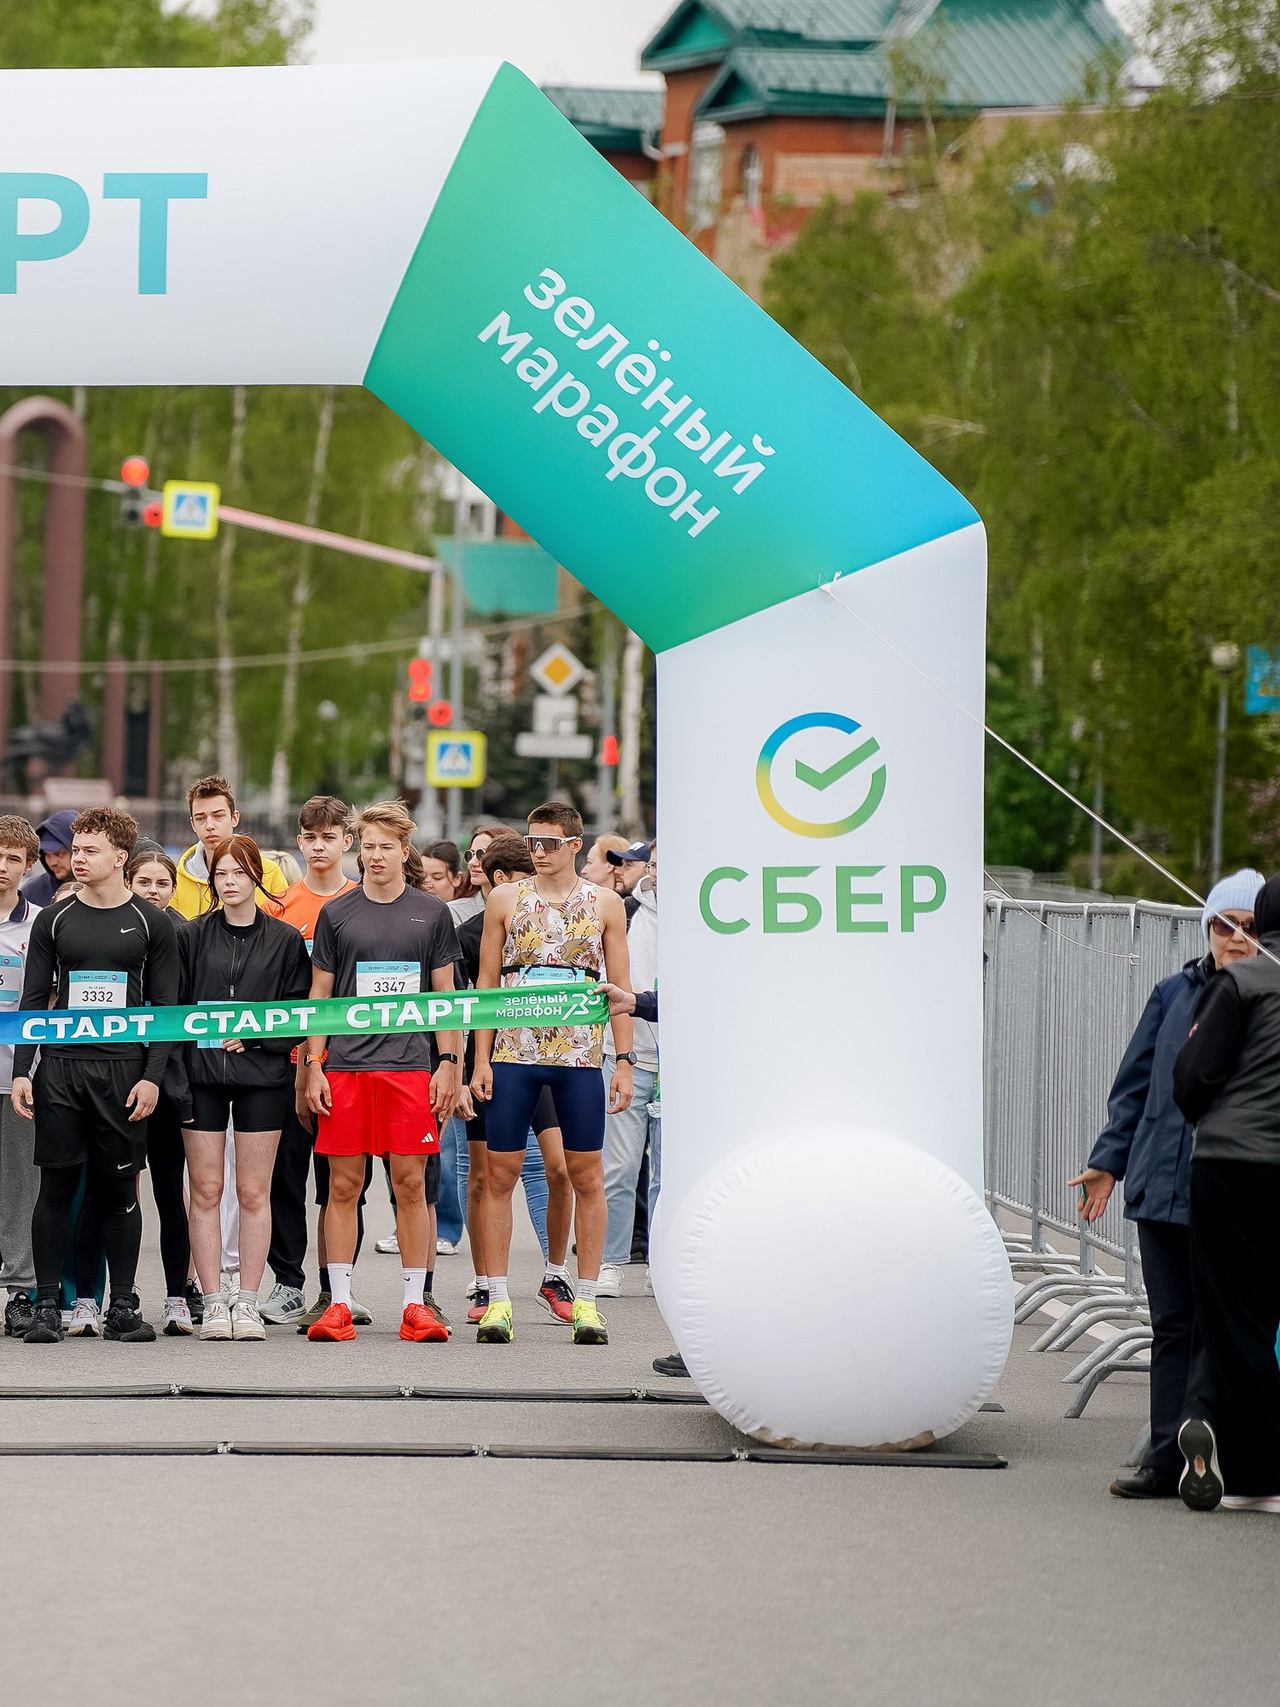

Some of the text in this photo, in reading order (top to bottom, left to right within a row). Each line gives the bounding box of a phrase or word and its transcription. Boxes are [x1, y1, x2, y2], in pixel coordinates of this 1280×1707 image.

[523, 267, 777, 496] зелёный
[477, 310, 721, 539] марафон
[699, 864, 947, 935] СБЕР
[82, 991, 114, 1003] 3332
[373, 981, 406, 993] 3347
[504, 991, 569, 1006] зелёный
[21, 1014, 154, 1041] СТАРТ
[183, 1006, 316, 1035] СТАРТ
[346, 996, 480, 1029] СТАРТ
[496, 1005, 562, 1019] марафон
